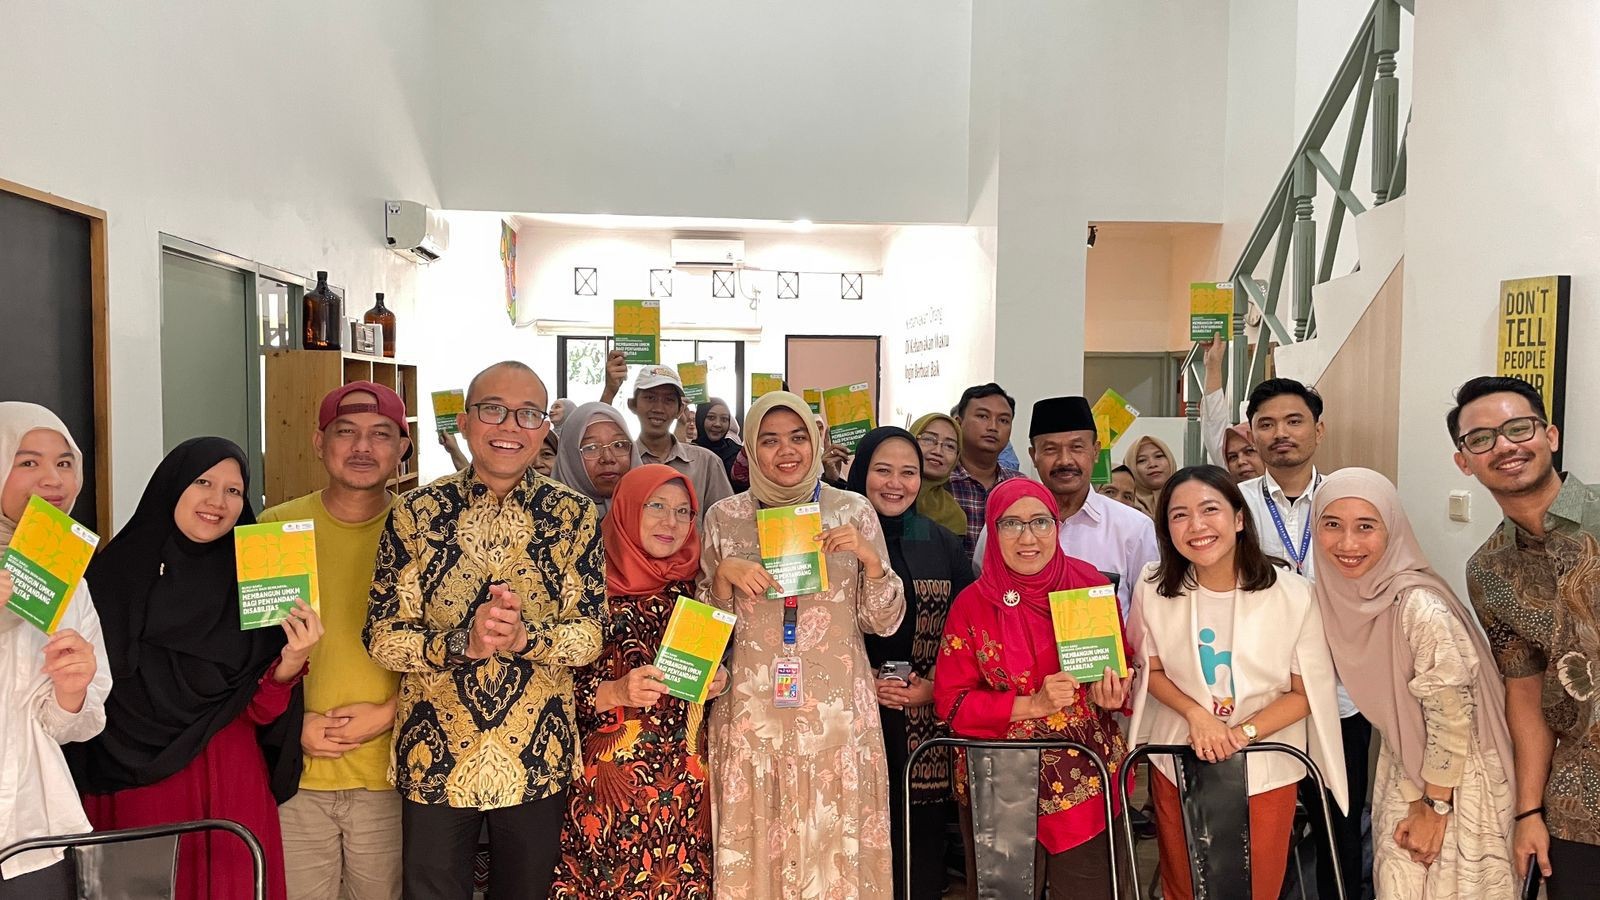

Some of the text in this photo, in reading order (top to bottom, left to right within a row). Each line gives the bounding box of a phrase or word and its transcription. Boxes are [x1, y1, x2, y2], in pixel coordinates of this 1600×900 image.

[1506, 286, 1549, 316] DON'T
[1505, 317, 1546, 347] TELL
[1504, 350, 1546, 369] PEOPLE
[4, 562, 56, 598] MEMBANGUN UMKM
[14, 578, 51, 604] PENYANDANG
[242, 590, 280, 600] MEMBANGUN
[243, 605, 279, 614] DISABILITAS
[1062, 650, 1093, 659] MEMBANGUN
[1076, 654, 1109, 664] PENYANDANG
[1064, 662, 1094, 672] DISABILITAS
